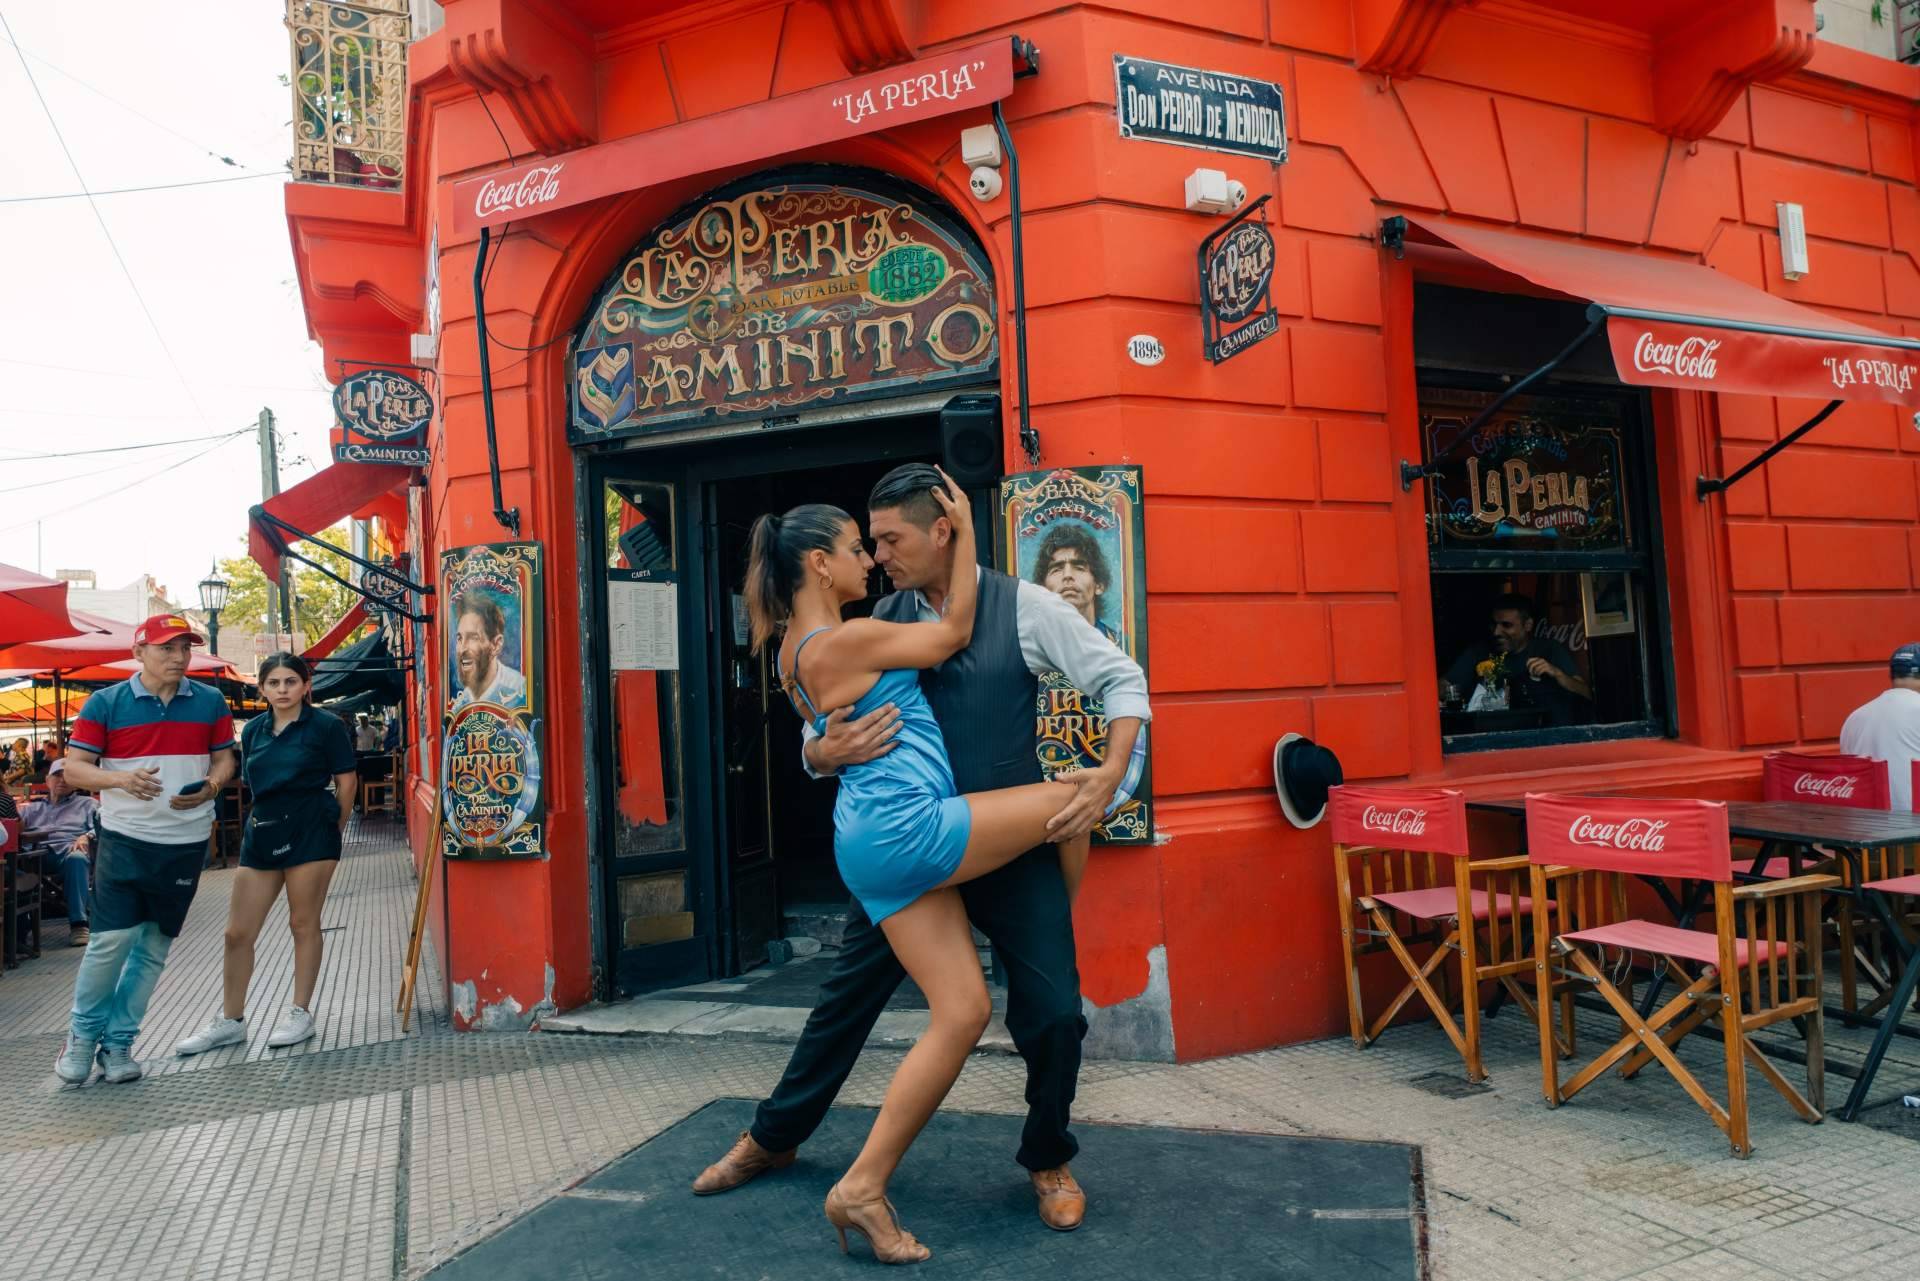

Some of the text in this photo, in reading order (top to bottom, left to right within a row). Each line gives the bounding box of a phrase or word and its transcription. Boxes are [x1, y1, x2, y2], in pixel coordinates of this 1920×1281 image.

[1157, 69, 1255, 98] AVENIDA
[1160, 89, 1202, 135] PEDRO
[1207, 105, 1222, 138] DE
[1226, 100, 1282, 148] MENDOZA
[475, 162, 565, 218] Coca-Cola
[602, 185, 912, 333] LA PERLA
[882, 262, 940, 290] 1882
[737, 311, 788, 338] DE
[1220, 317, 1269, 358] CAMINITO
[577, 302, 995, 422] CAMINITO
[1634, 332, 1722, 380] Coca-Cola
[388, 380, 414, 395] BAR
[345, 445, 419, 461] CAMINITO
[1045, 480, 1087, 499] BAR
[1534, 509, 1585, 529] CAMINITO
[468, 558, 499, 573] BAR
[1049, 688, 1087, 716] LA
[449, 752, 523, 794] PERLA
[1794, 773, 1861, 800] Coca-Cola
[456, 803, 512, 818] CAMINITO
[1362, 805, 1428, 836] Coca-Cola
[1568, 814, 1670, 852] Coca-Cola
